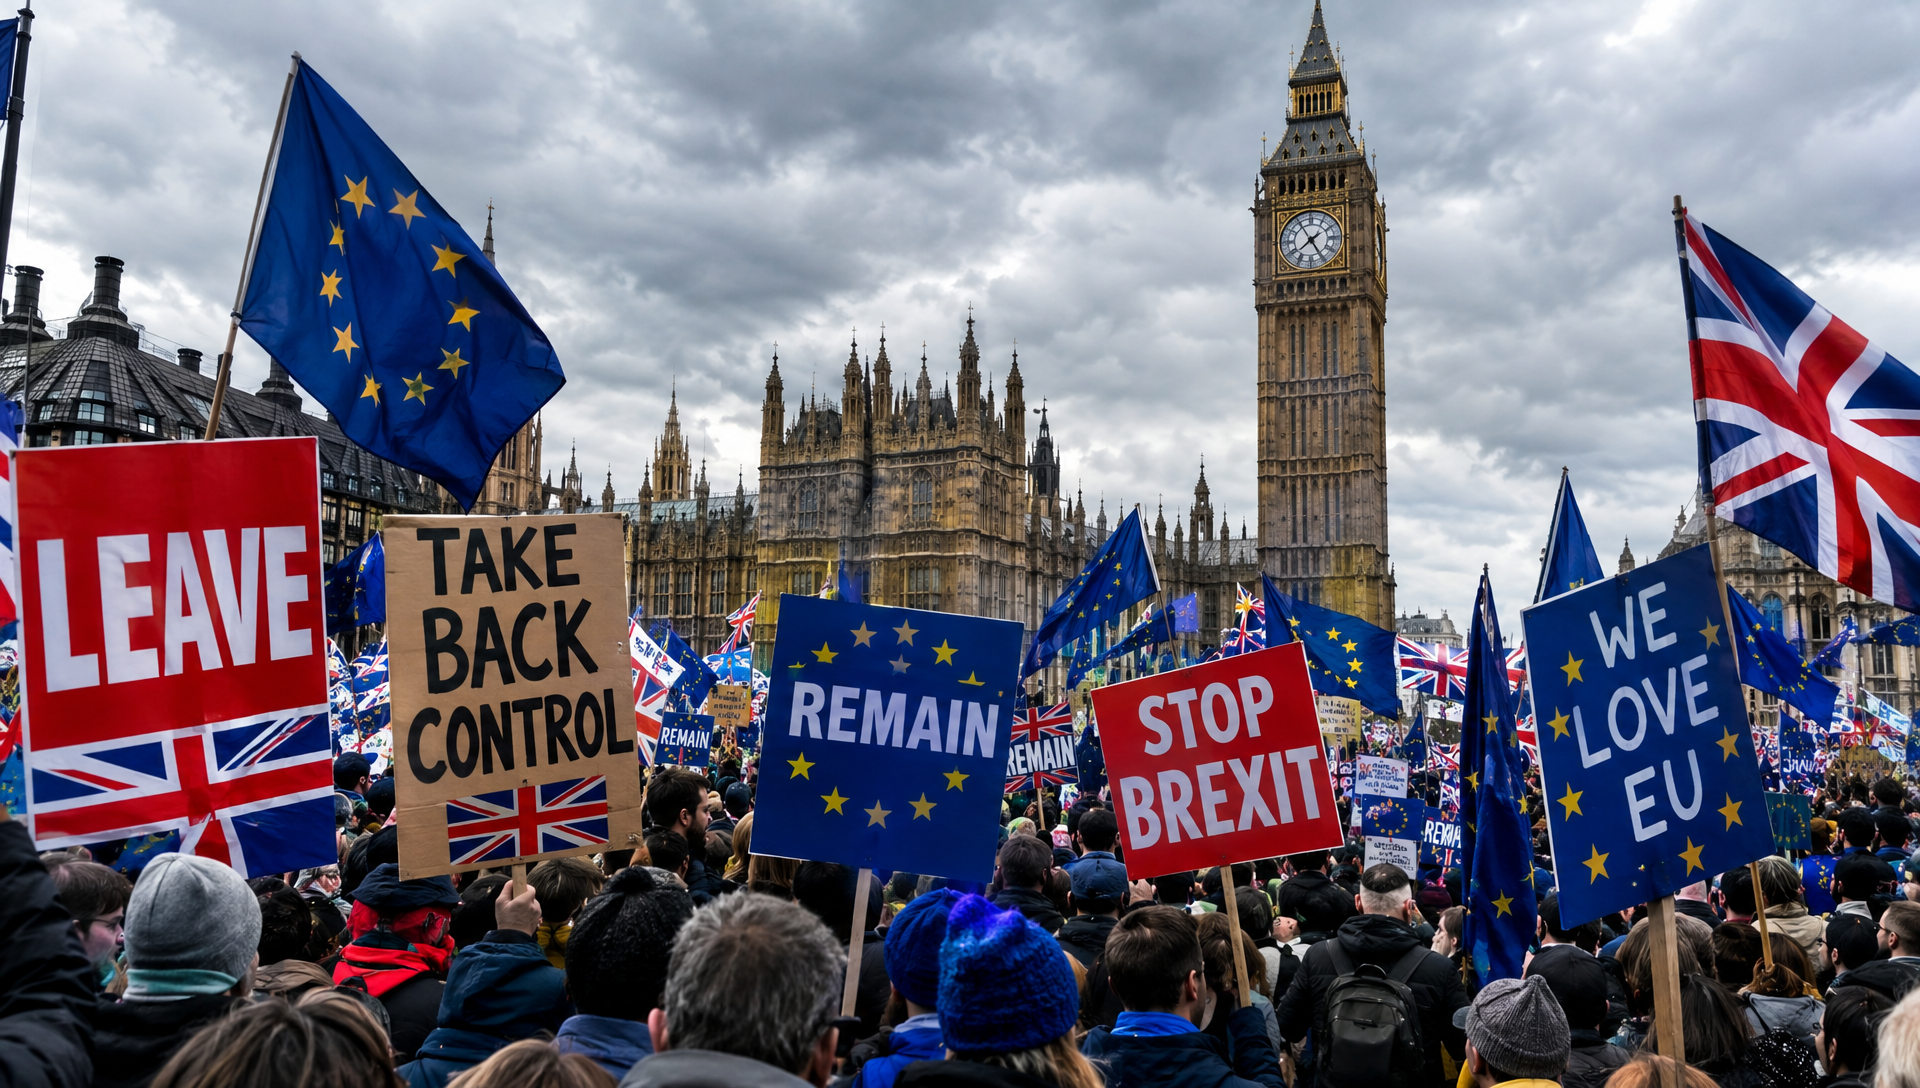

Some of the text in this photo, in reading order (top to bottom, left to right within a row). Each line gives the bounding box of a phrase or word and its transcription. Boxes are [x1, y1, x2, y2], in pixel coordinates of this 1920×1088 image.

[416, 523, 581, 596] TAKE
[36, 525, 313, 693] LEAVE
[422, 598, 599, 695] BACK
[1588, 581, 1678, 669] WE
[406, 688, 635, 785] CONTROL
[660, 726, 710, 749] REMAIN
[789, 681, 999, 758] REMAIN
[1006, 735, 1076, 777] REMAIN
[1138, 675, 1275, 757] STOP
[1572, 653, 1720, 769] LOVE
[1119, 745, 1322, 851] BREXIT
[1624, 749, 1704, 843] EU
